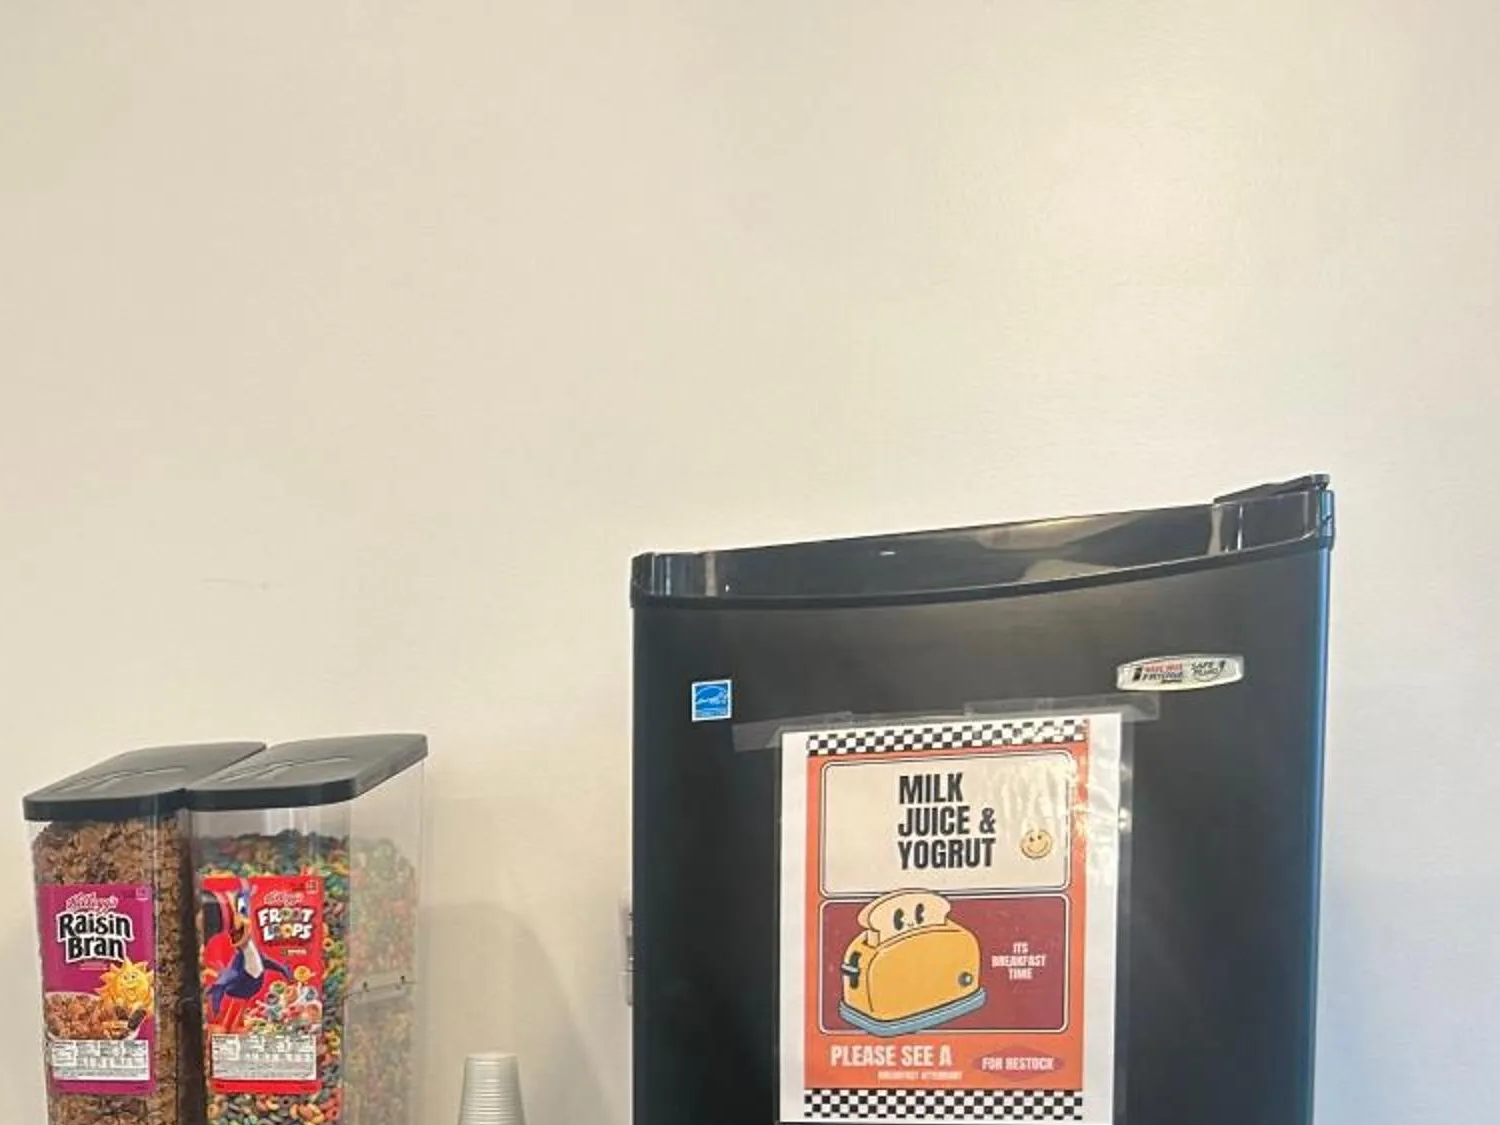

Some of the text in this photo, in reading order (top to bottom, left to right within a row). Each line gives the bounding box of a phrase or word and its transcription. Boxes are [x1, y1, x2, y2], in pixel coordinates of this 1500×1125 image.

[899, 772, 963, 804] MILK
[898, 805, 996, 836] JUICE &
[898, 837, 996, 870] YOGRUT
[57, 912, 133, 940] Raisin
[263, 923, 312, 942] LOOPS
[66, 936, 125, 961] Bran
[1009, 967, 1032, 980] TIME
[831, 1044, 952, 1067] PLEASE SEE A
